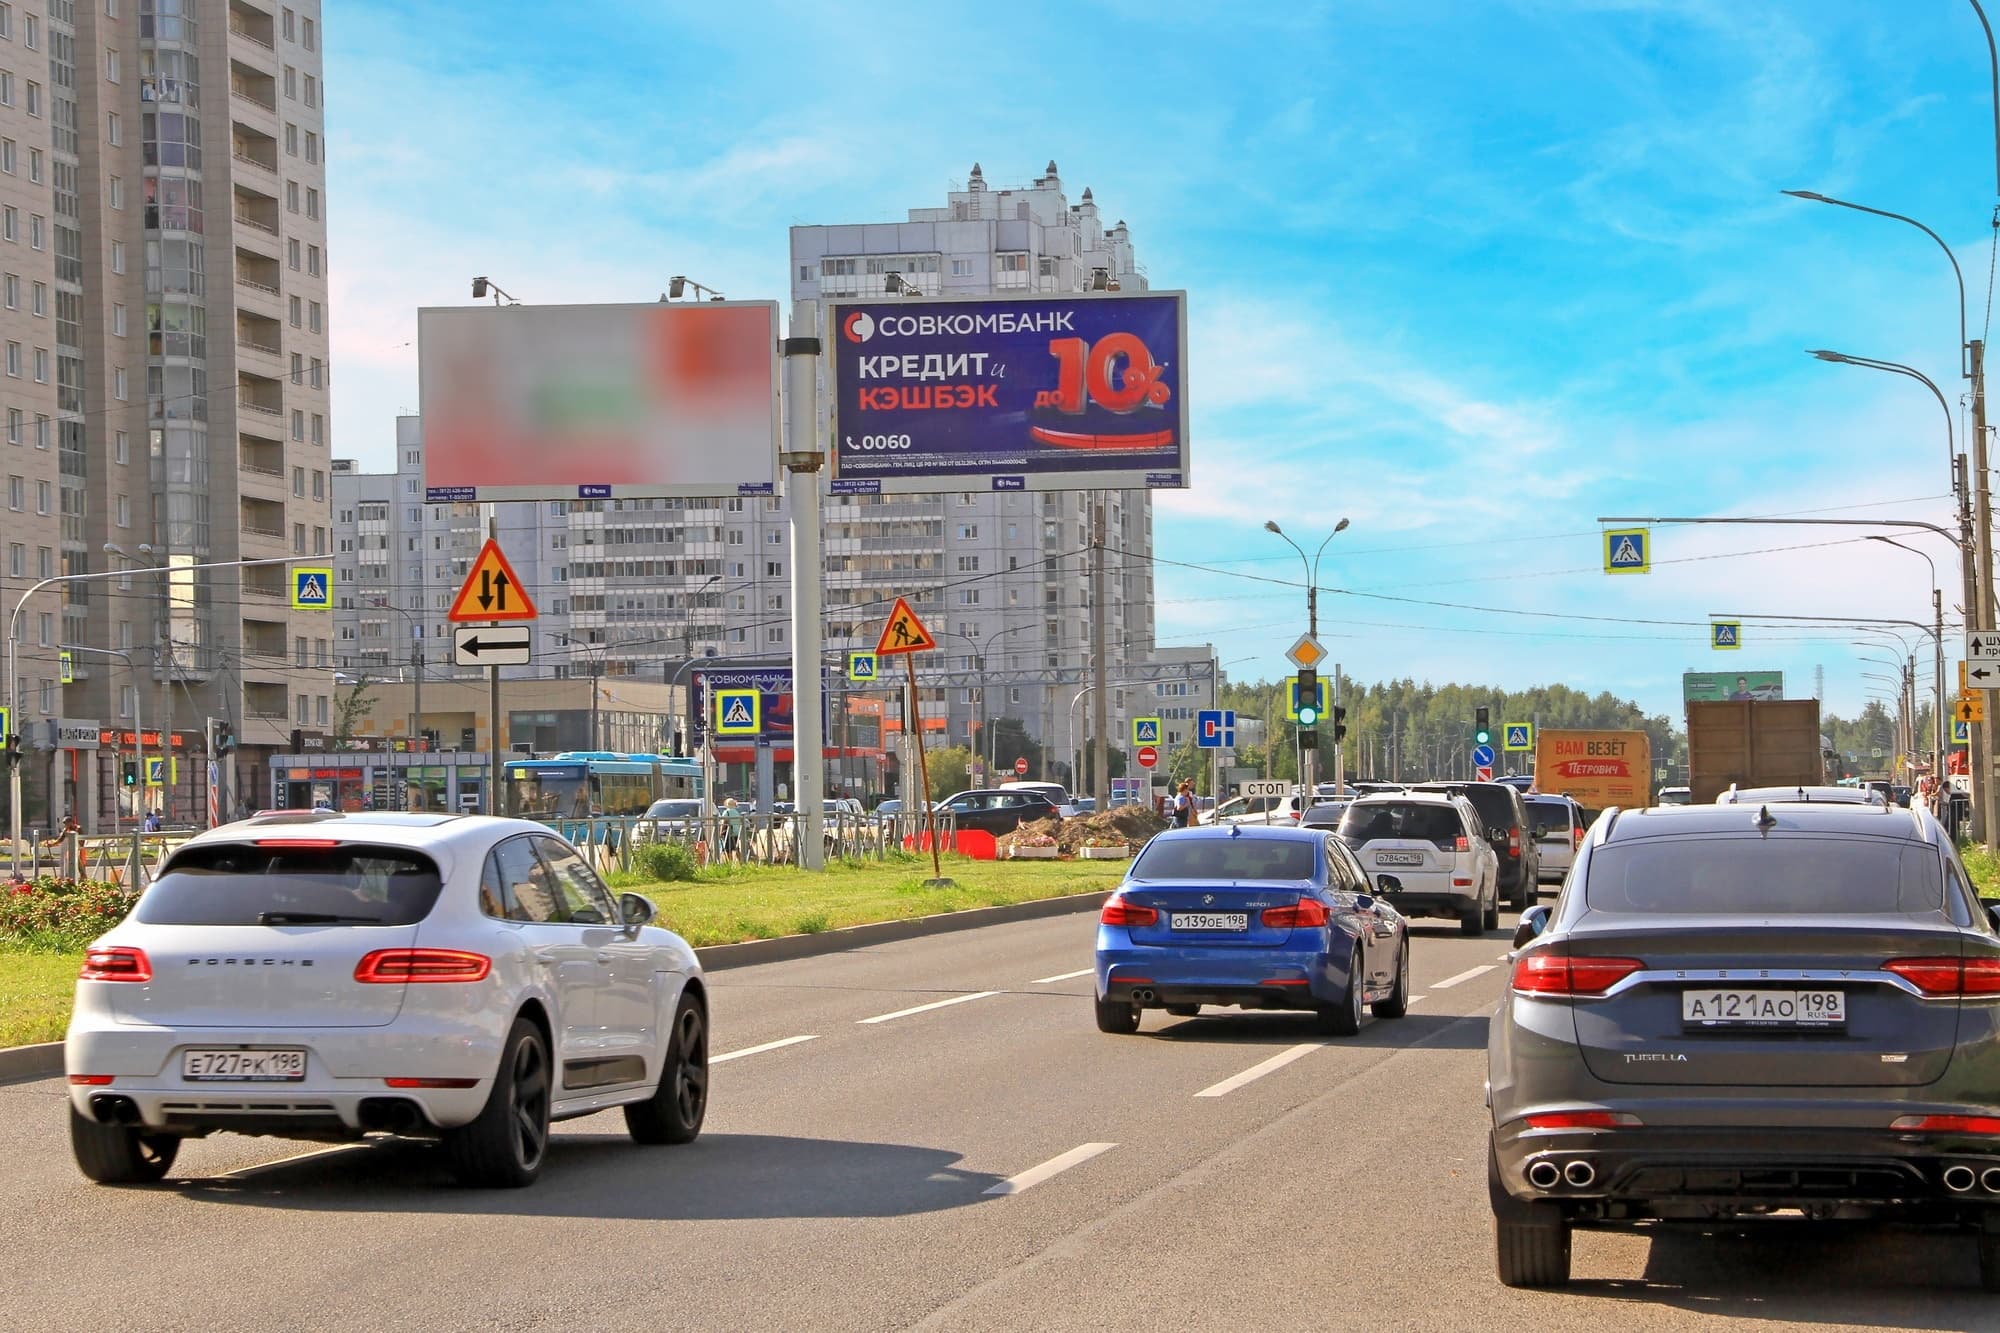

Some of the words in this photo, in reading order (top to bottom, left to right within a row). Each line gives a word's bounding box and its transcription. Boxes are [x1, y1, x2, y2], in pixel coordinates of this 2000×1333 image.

[879, 311, 1074, 337] СОВКОМБАНК
[858, 352, 989, 382] КРЕДИТ
[858, 384, 999, 411] КЭШБЭК
[862, 434, 911, 450] 0060
[1555, 740, 1584, 756] ВАМ
[1587, 738, 1627, 756] ВЕЗЁТ
[1248, 783, 1284, 795] СТОП
[1226, 915, 1245, 925] 198
[188, 958, 313, 967] PORSCHE
[1676, 970, 1849, 978] GEELY
[1691, 994, 1794, 1017] А121АО
[1799, 994, 1838, 1011] 198
[1808, 1011, 1827, 1019] RUS
[191, 1054, 266, 1074] Е727РК
[271, 1054, 301, 1069] 198
[1624, 1054, 1688, 1064] TUGELLA
